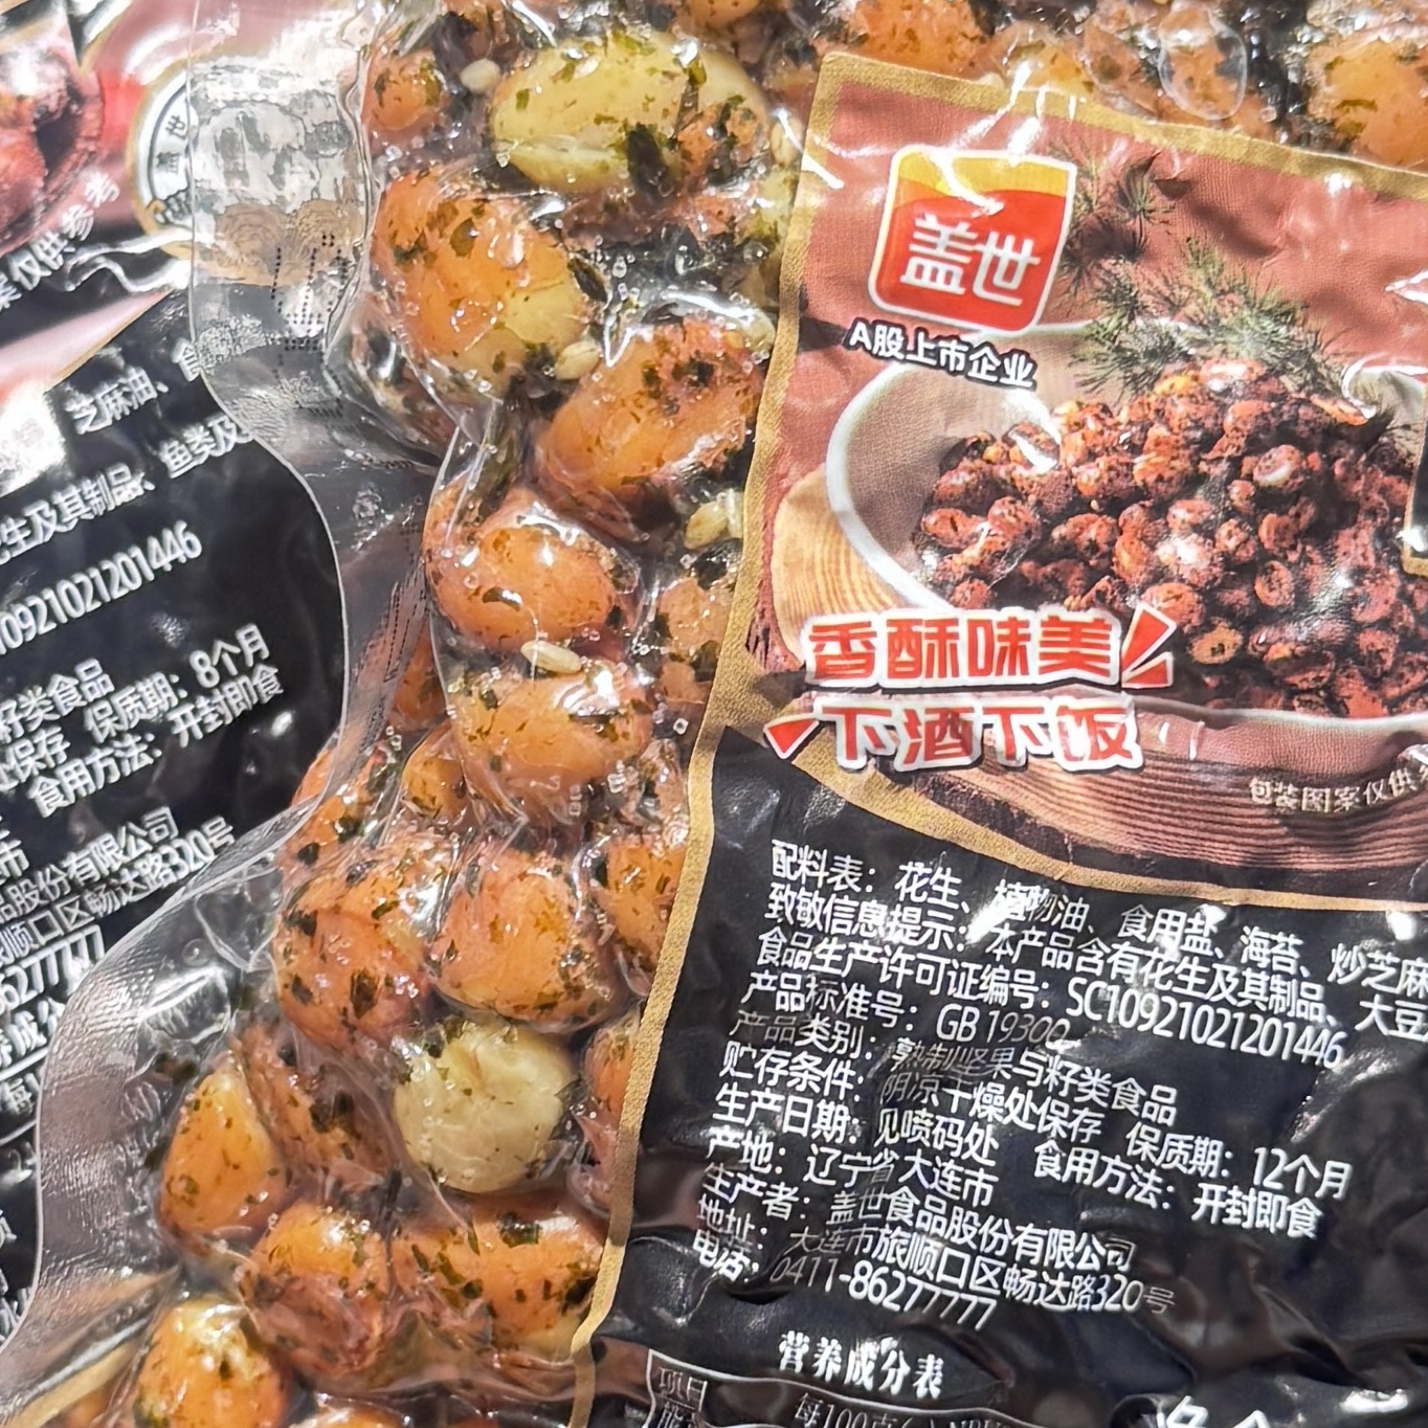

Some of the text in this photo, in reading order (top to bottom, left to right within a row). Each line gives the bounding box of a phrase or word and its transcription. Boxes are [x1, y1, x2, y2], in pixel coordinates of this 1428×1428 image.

[899, 213, 1041, 309] 盖世
[848, 320, 1037, 389] A股上市企业
[808, 612, 1114, 683] 香酥味美
[821, 702, 1139, 766] 下酒下饭
[985, 1008, 1073, 1049] 19300
[1034, 1139, 1324, 1242] 食用方法：开封即食
[1125, 1120, 1353, 1202] 保质期：12个月
[779, 1330, 945, 1401] 营养成分表
